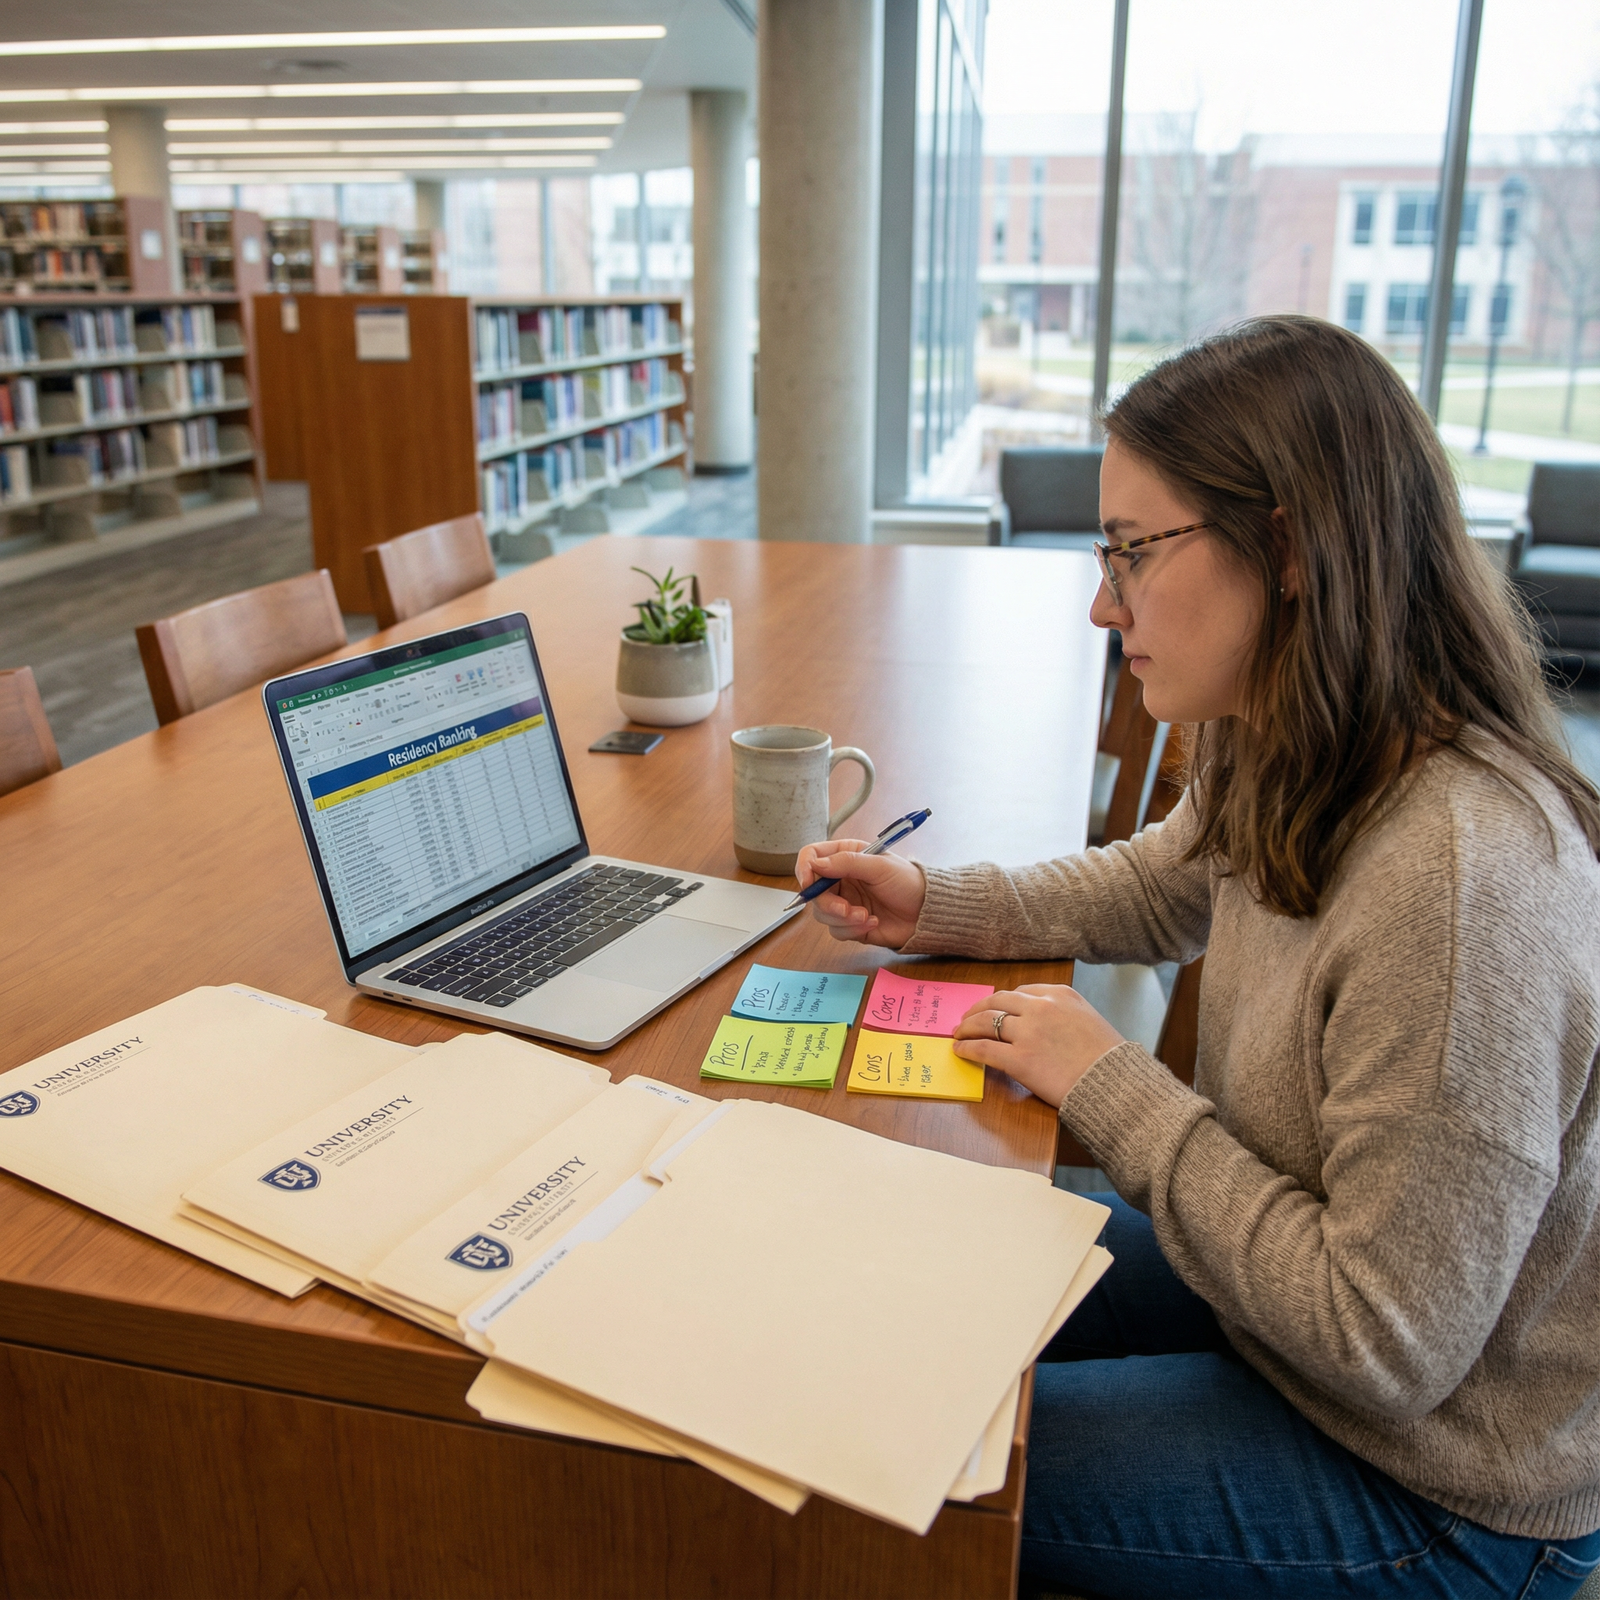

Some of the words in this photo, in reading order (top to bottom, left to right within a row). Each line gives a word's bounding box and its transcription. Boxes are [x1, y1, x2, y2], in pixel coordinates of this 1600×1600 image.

[388, 740, 438, 768] Residency
[438, 725, 477, 749] Ranking
[741, 987, 770, 1009] Pros
[871, 994, 896, 1022] Cons
[32, 1036, 144, 1090] UNIVERSITY
[709, 1041, 739, 1068] Pros
[858, 1053, 883, 1081] Cons
[304, 1094, 413, 1159] UNIVERSITY
[487, 1155, 586, 1232] UNIVERSITY
